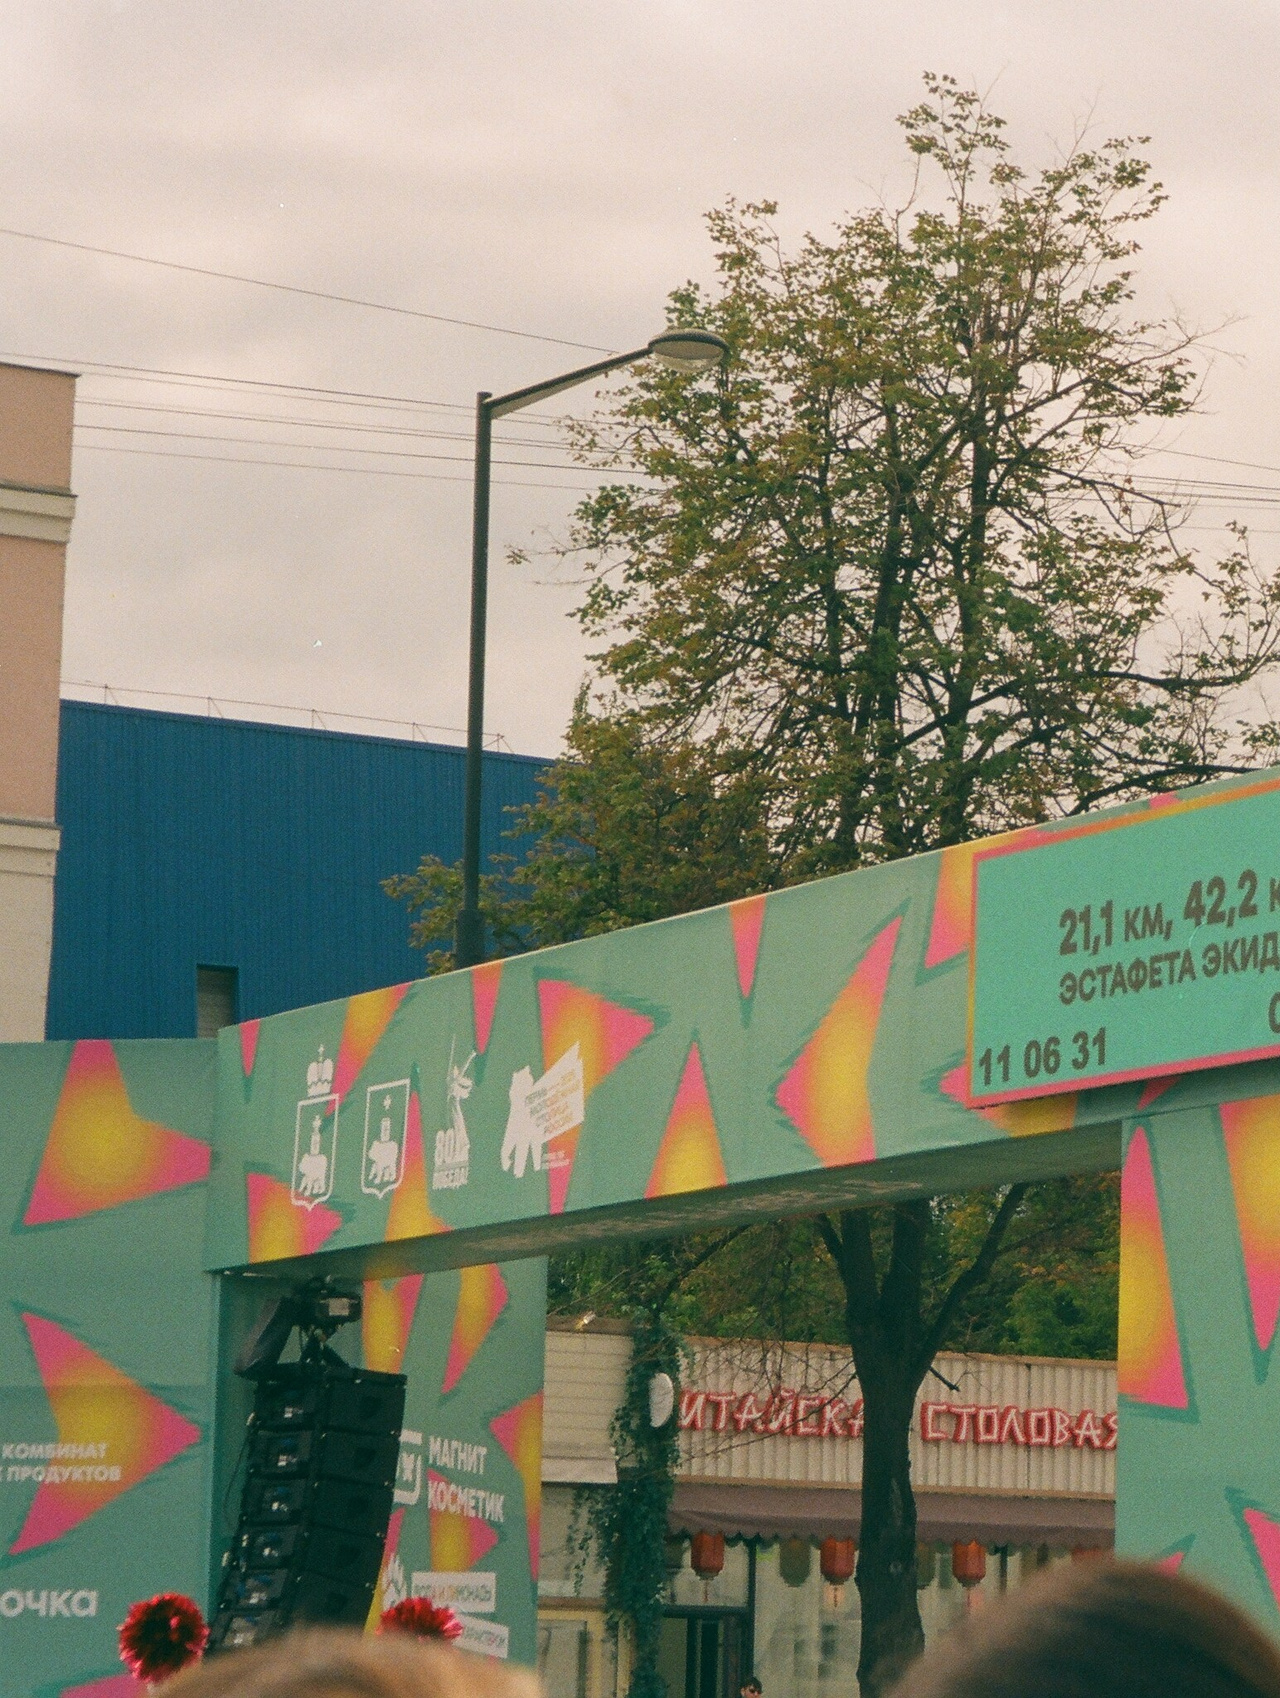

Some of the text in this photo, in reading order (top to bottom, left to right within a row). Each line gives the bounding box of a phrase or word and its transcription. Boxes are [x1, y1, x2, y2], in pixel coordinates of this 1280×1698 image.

[1059, 899, 1113, 956] 21,1
[1183, 868, 1258, 928] 42,2
[1059, 948, 1197, 1006] ЭСТАФЕТА
[979, 1027, 1107, 1086] 11 06 31
[678, 1384, 865, 1439] ИТАЙСКА
[1, 1442, 107, 1460] КОМБИНАТ
[6, 1465, 122, 1484] ПРОДУКТОВ
[428, 1435, 488, 1476] МАГНИТ
[426, 1480, 506, 1524] КОСМЕТИК
